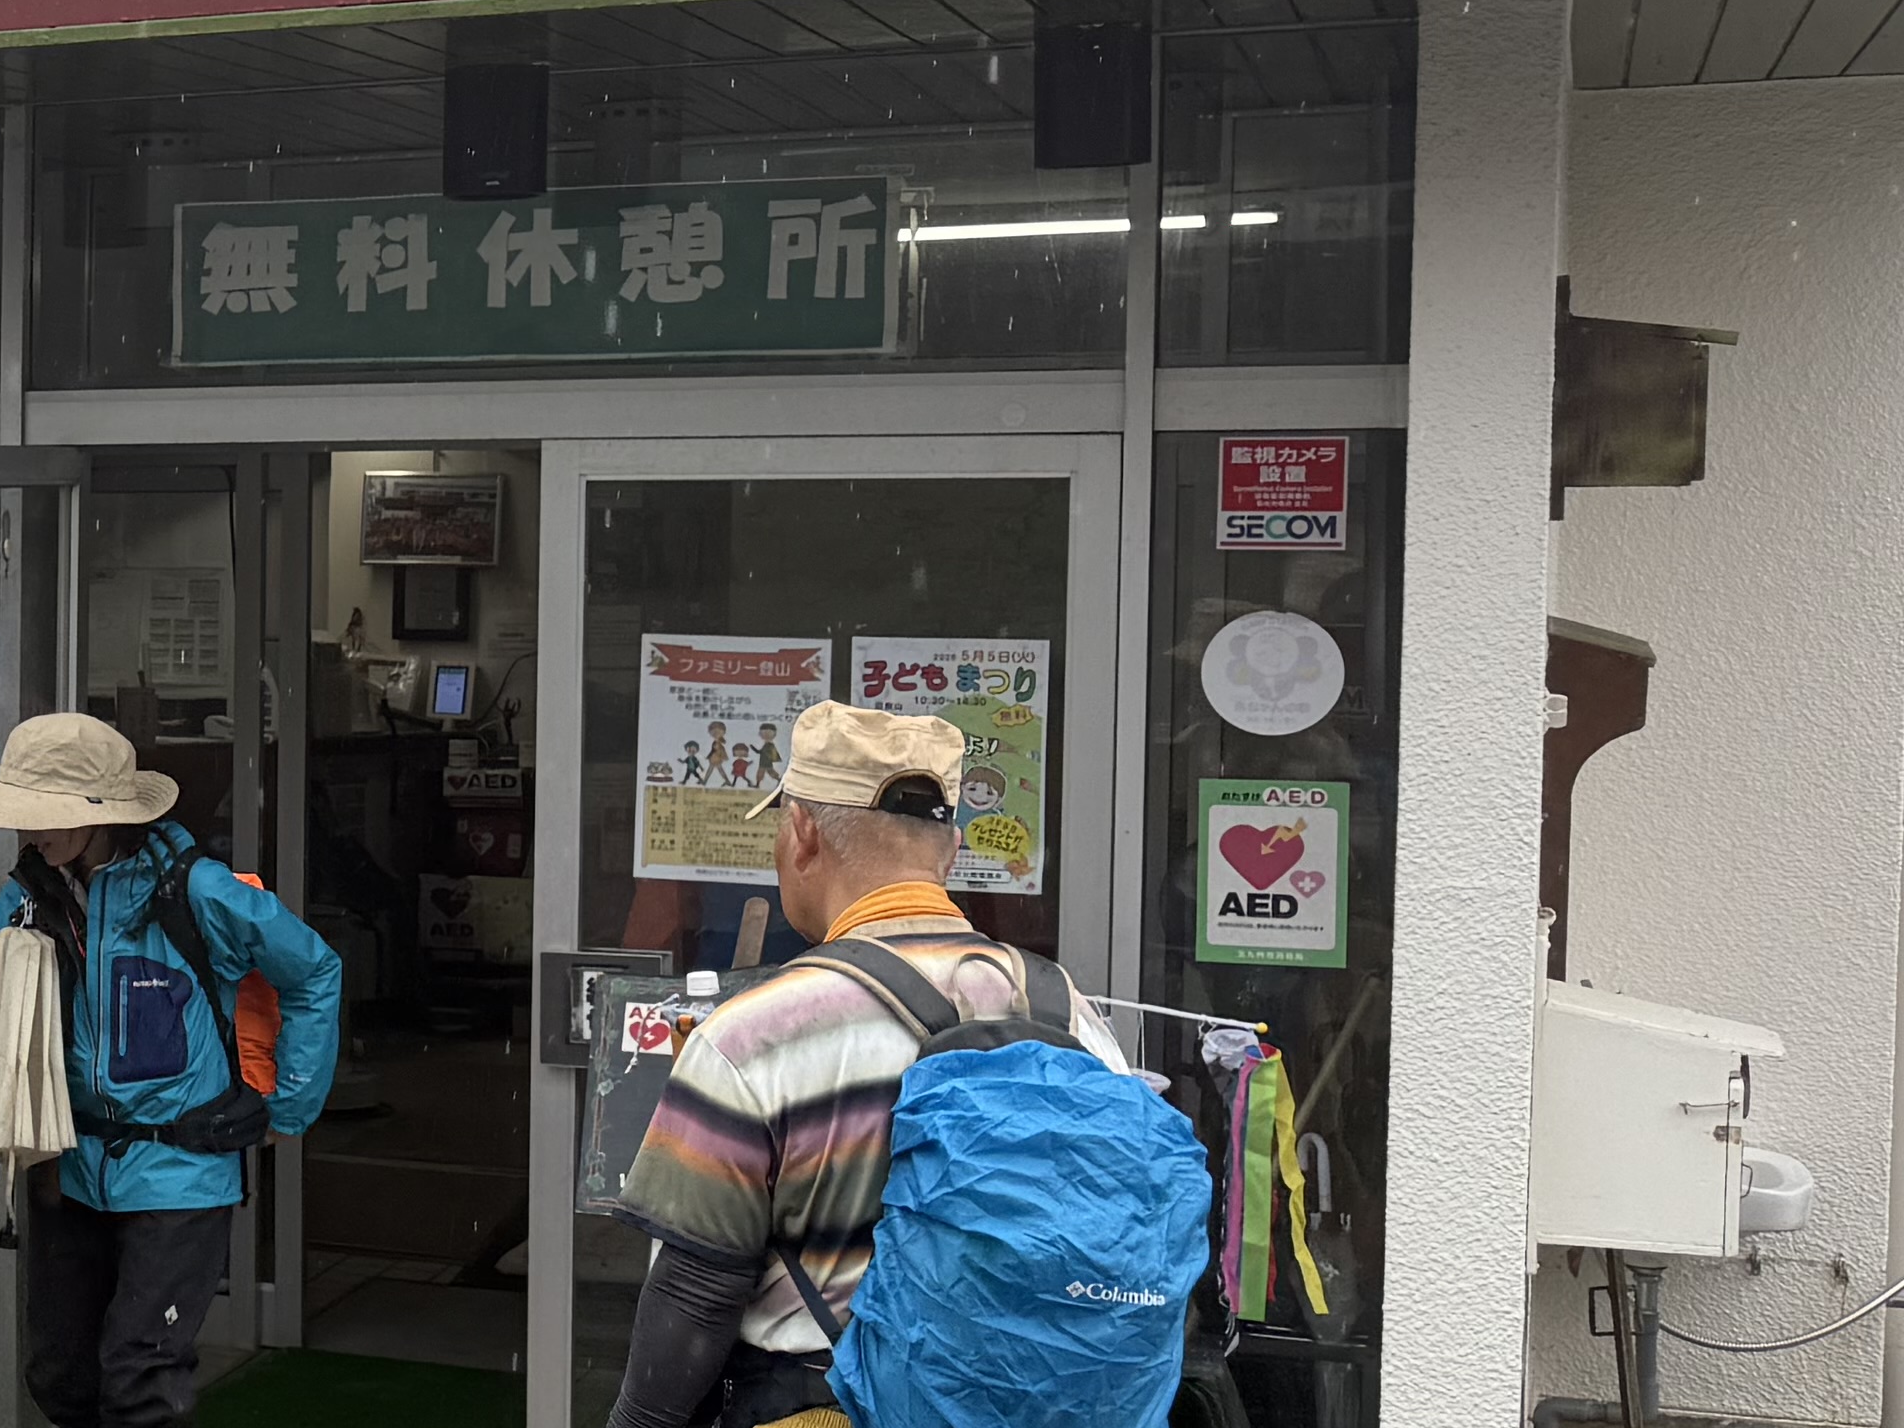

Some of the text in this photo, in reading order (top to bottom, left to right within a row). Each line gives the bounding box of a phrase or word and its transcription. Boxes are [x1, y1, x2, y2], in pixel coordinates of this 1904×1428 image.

[198, 193, 877, 317] 無料休憩所
[1231, 446, 1337, 463] 監視カメラ
[1259, 465, 1306, 483] 設置
[1226, 515, 1337, 539] SECOM
[679, 658, 791, 677] ファミリー登山
[999, 709, 1028, 723] 無料
[467, 774, 518, 789] AED
[1265, 788, 1326, 805] AED
[1218, 891, 1299, 919] AED
[429, 923, 475, 938] AED
[629, 1003, 659, 1020] AE
[1085, 1283, 1166, 1307] Columbia
